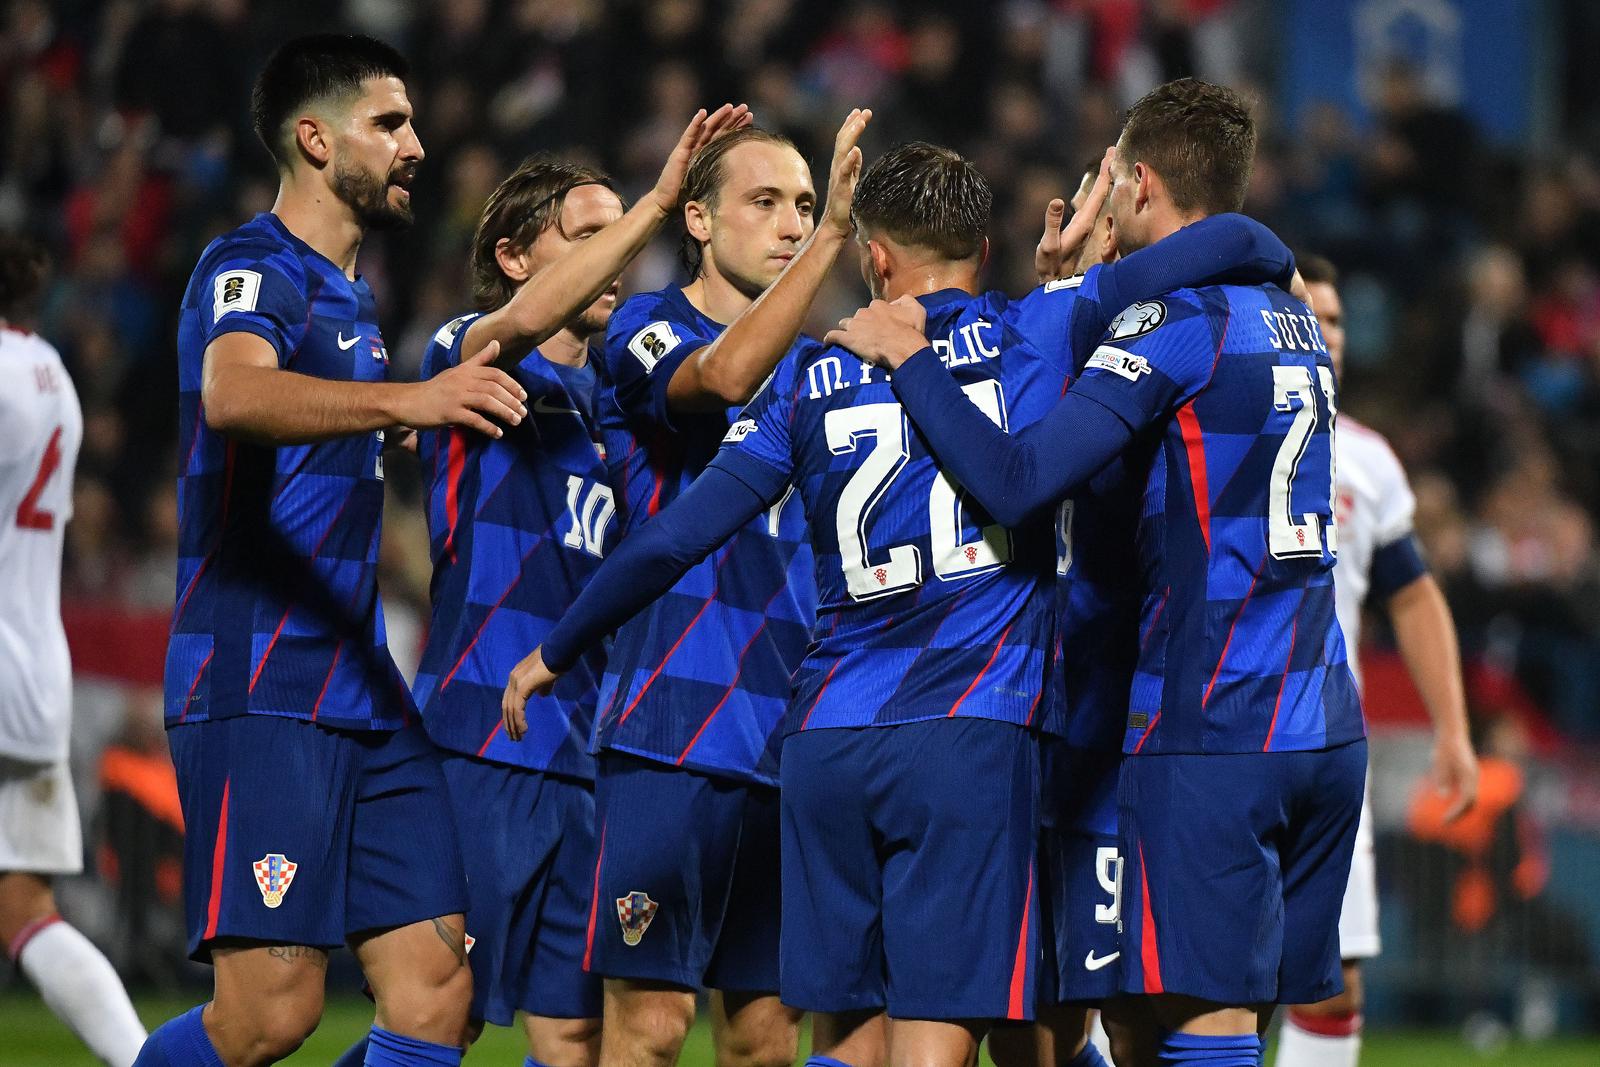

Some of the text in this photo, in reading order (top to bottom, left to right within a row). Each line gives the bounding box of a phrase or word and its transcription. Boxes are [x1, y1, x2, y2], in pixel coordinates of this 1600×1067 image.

[1121, 356, 1140, 373] 10
[563, 475, 616, 560] 10
[1095, 846, 1124, 926] 9
